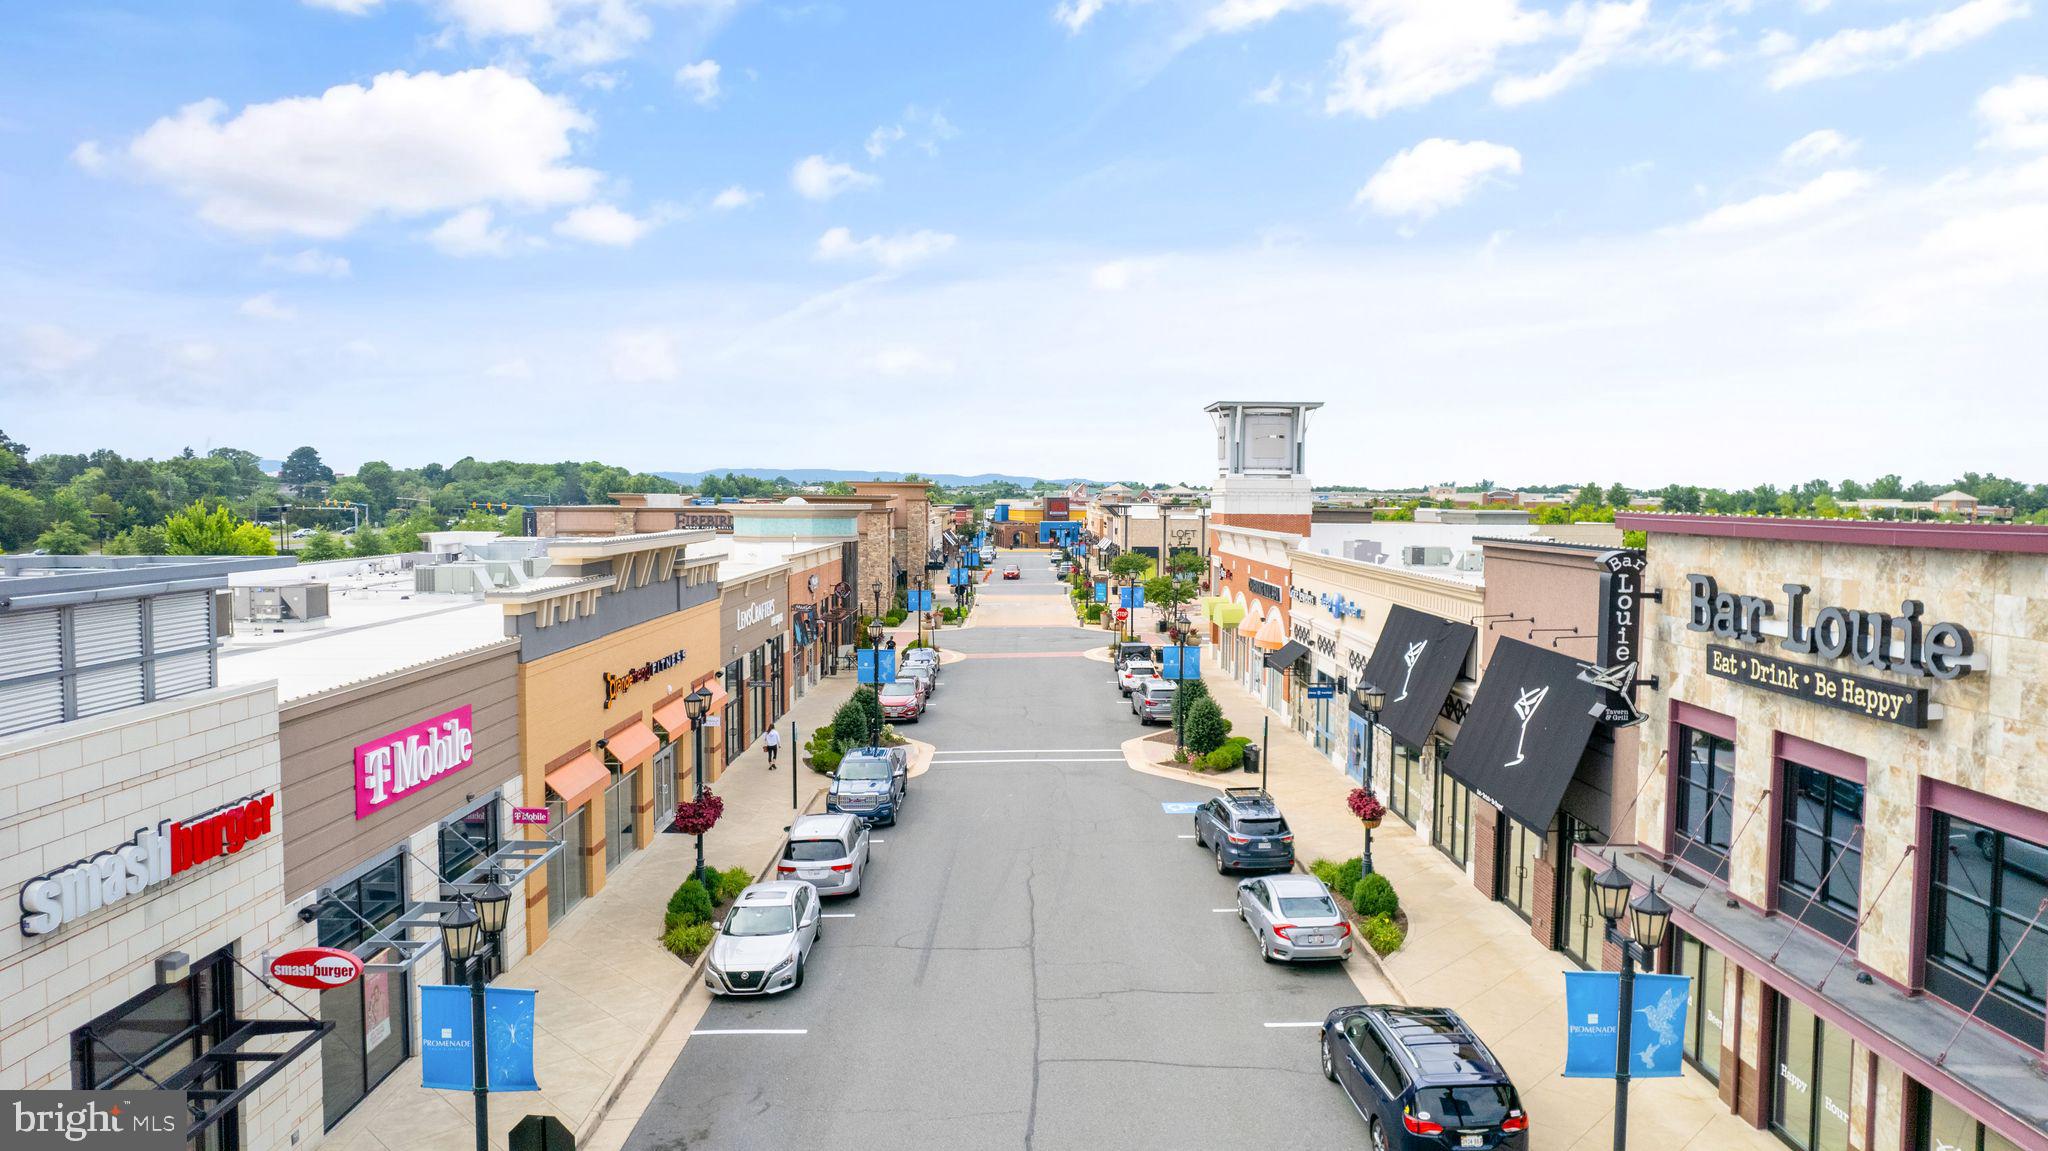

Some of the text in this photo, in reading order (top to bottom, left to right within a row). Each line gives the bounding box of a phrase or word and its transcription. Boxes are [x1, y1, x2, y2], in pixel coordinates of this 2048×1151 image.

[1171, 529, 1197, 538] LOFT
[1608, 556, 1646, 573] Bar
[1616, 573, 1634, 662] Louie
[1686, 573, 1775, 645] Bar
[1780, 583, 1974, 680] Louie
[1713, 650, 1738, 675] Eat
[1750, 657, 1799, 690] Drink
[1814, 672, 1837, 699] Be
[423, 1039, 471, 1048] PROMENADE
[1569, 1025, 1617, 1034] PROMENADE
[1781, 1063, 1808, 1093] Happy
[1825, 1096, 1850, 1124] Hour
